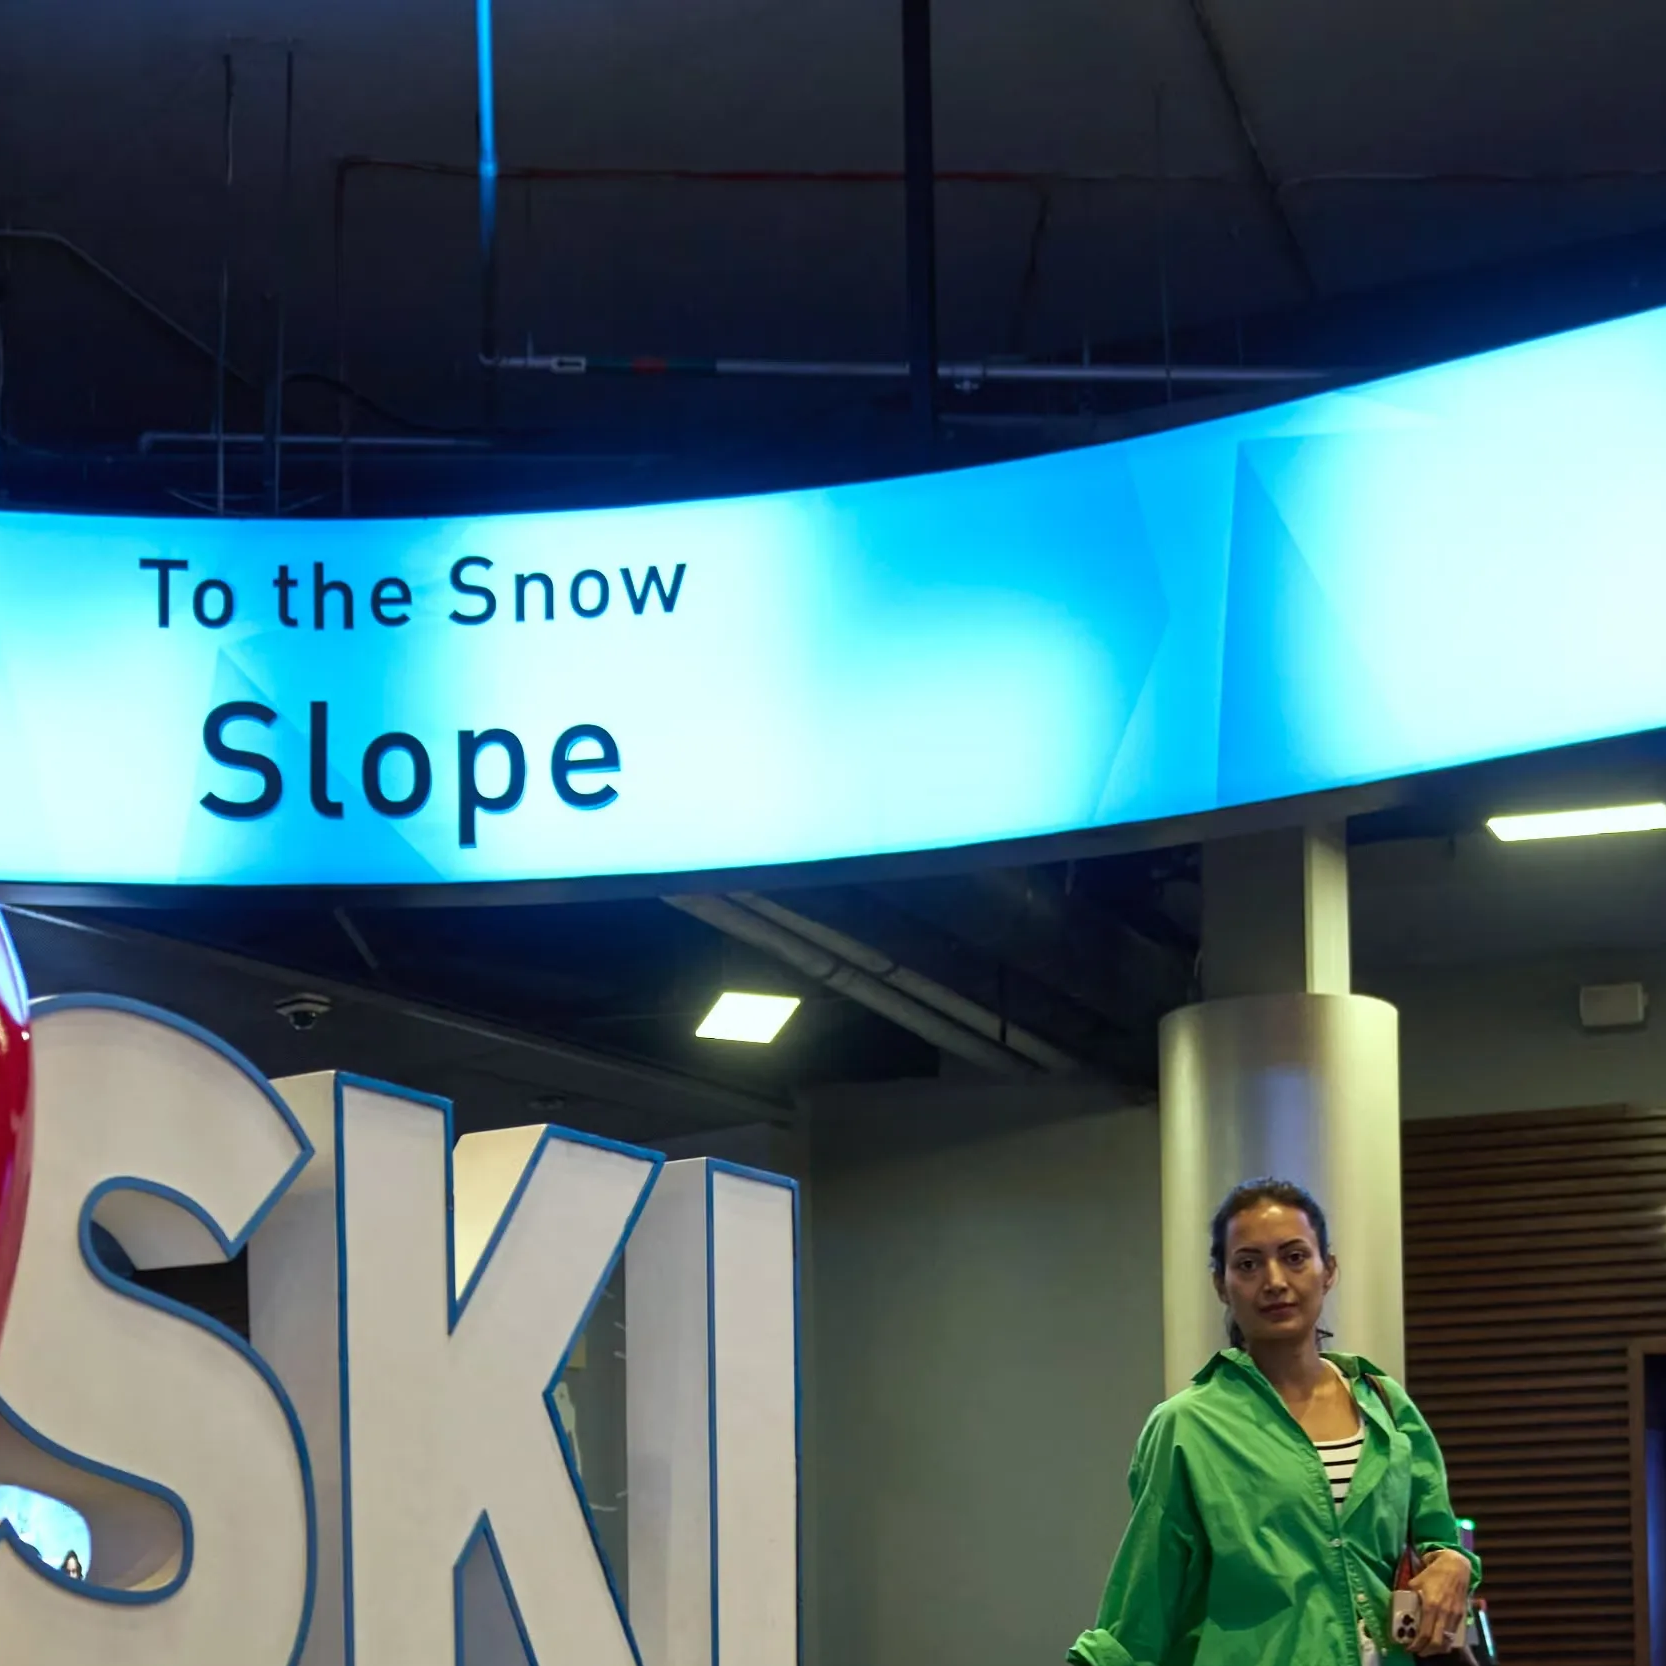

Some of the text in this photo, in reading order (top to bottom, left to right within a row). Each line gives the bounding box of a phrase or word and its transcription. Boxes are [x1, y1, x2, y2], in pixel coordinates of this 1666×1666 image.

[138, 554, 687, 631] To the Snow
[198, 699, 623, 849] Slope
